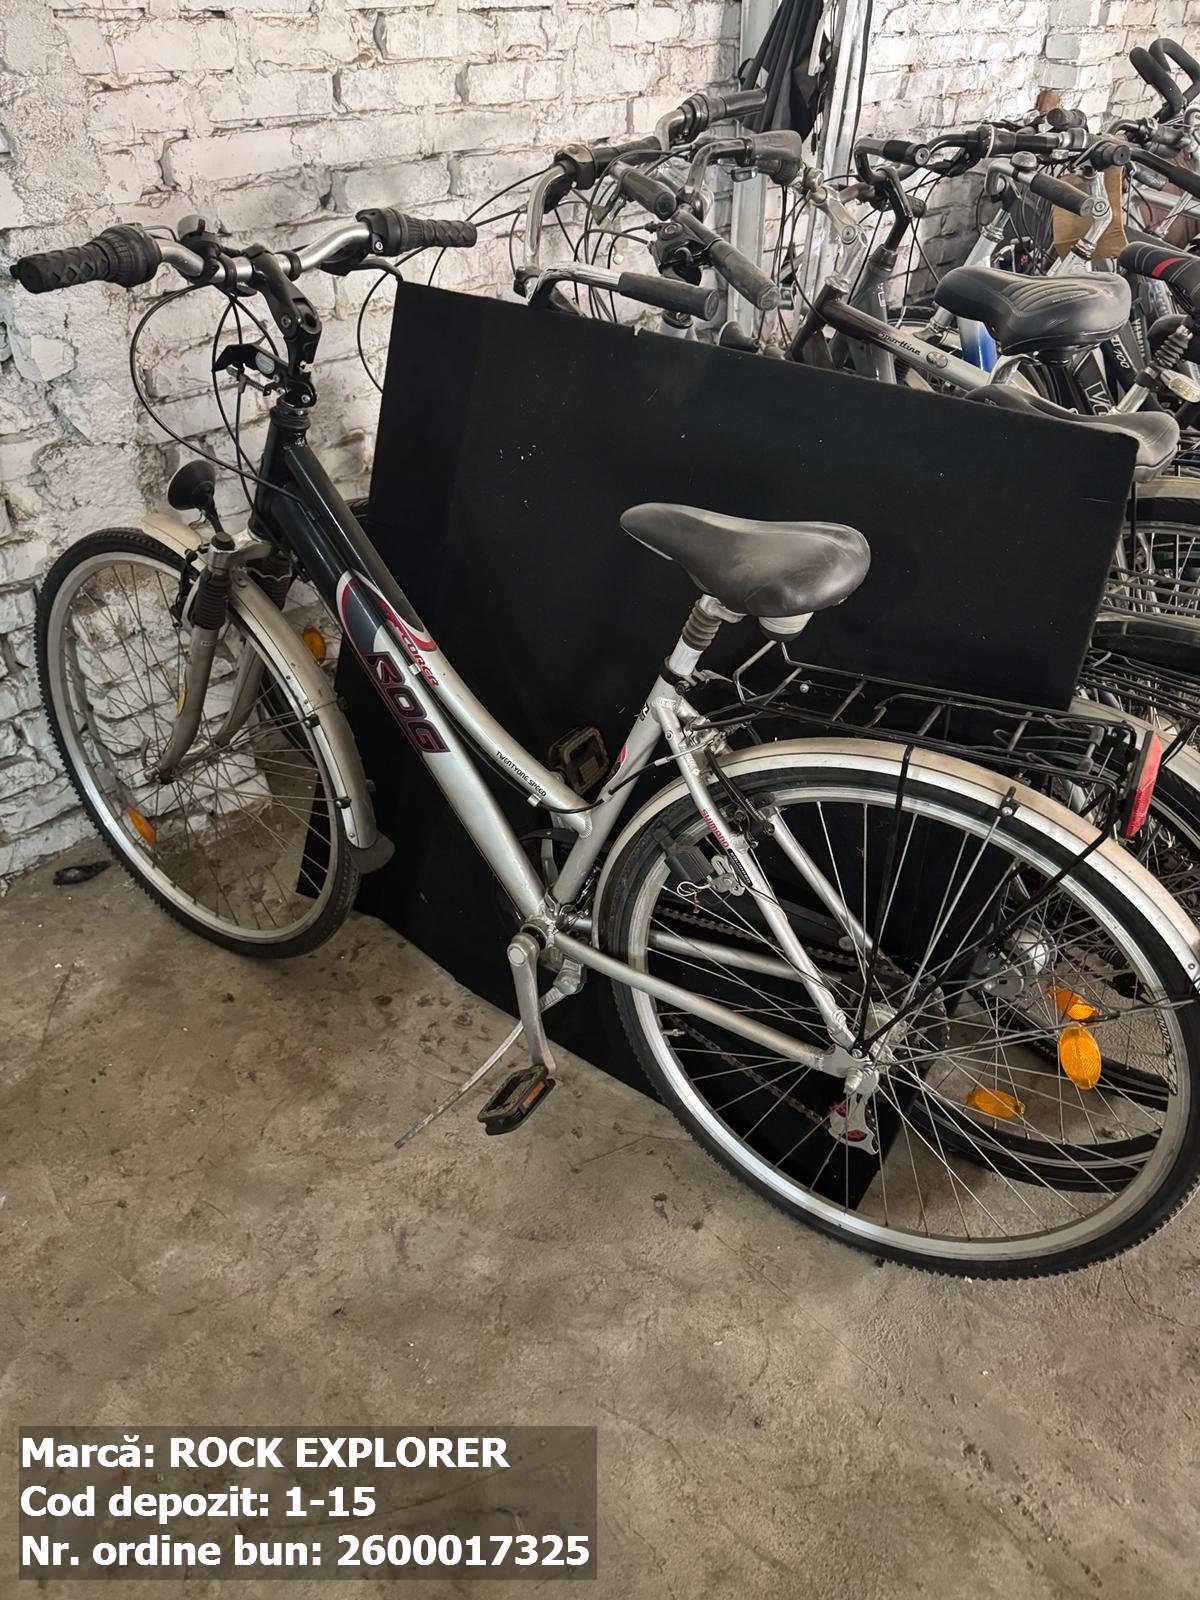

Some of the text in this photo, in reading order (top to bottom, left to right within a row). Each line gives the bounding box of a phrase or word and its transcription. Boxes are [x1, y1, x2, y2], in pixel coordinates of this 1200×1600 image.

[496, 751, 547, 797] TWENTYONE SPEED
[701, 809, 730, 848] SHIMANO
